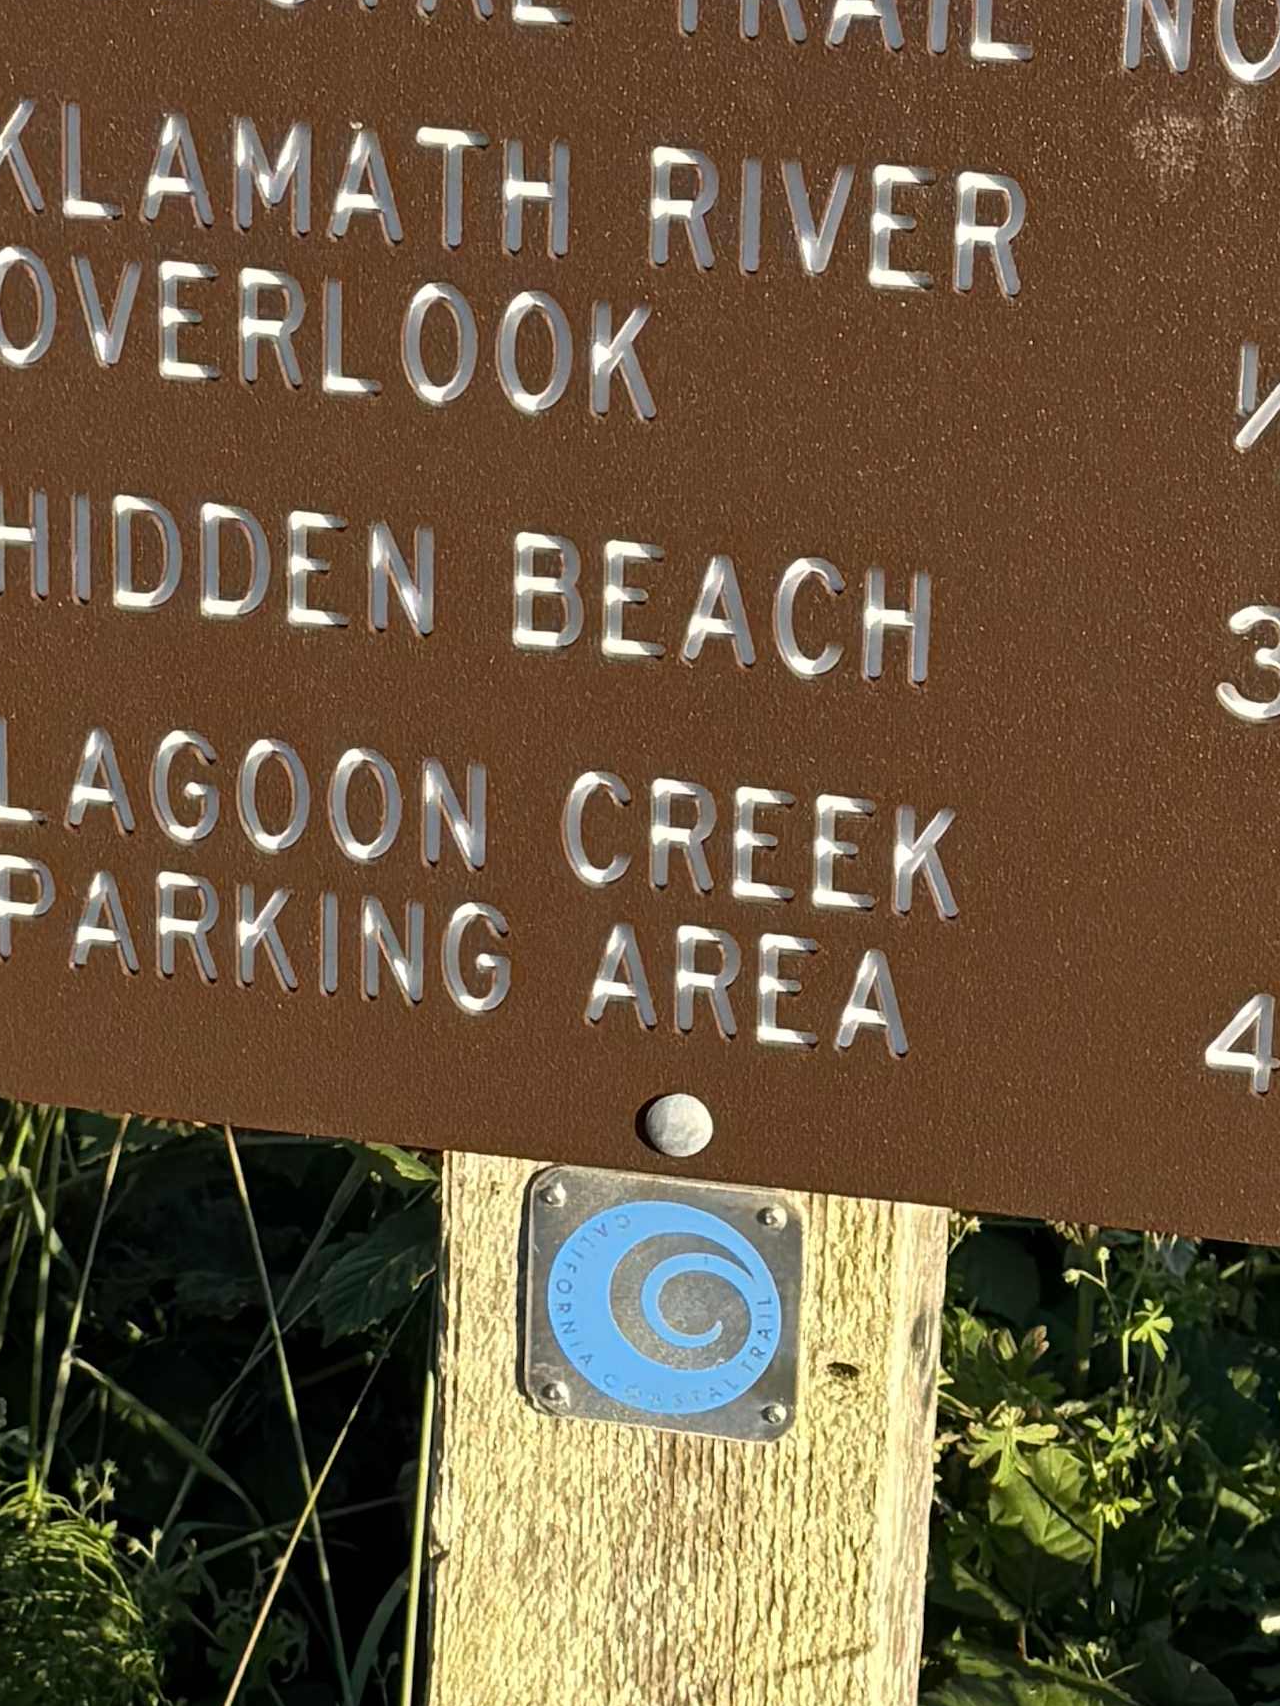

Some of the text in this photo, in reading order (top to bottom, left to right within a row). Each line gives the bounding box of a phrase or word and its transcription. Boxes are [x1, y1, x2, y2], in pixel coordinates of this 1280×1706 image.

[648, 146, 1028, 299] RIVER
[512, 532, 930, 686] BEACH
[563, 771, 958, 920] CREEK
[586, 925, 908, 1059] AREA
[1205, 994, 1280, 1095] 4
[556, 1213, 632, 1369] CALIFORNIA
[743, 1297, 775, 1373] TRAIL
